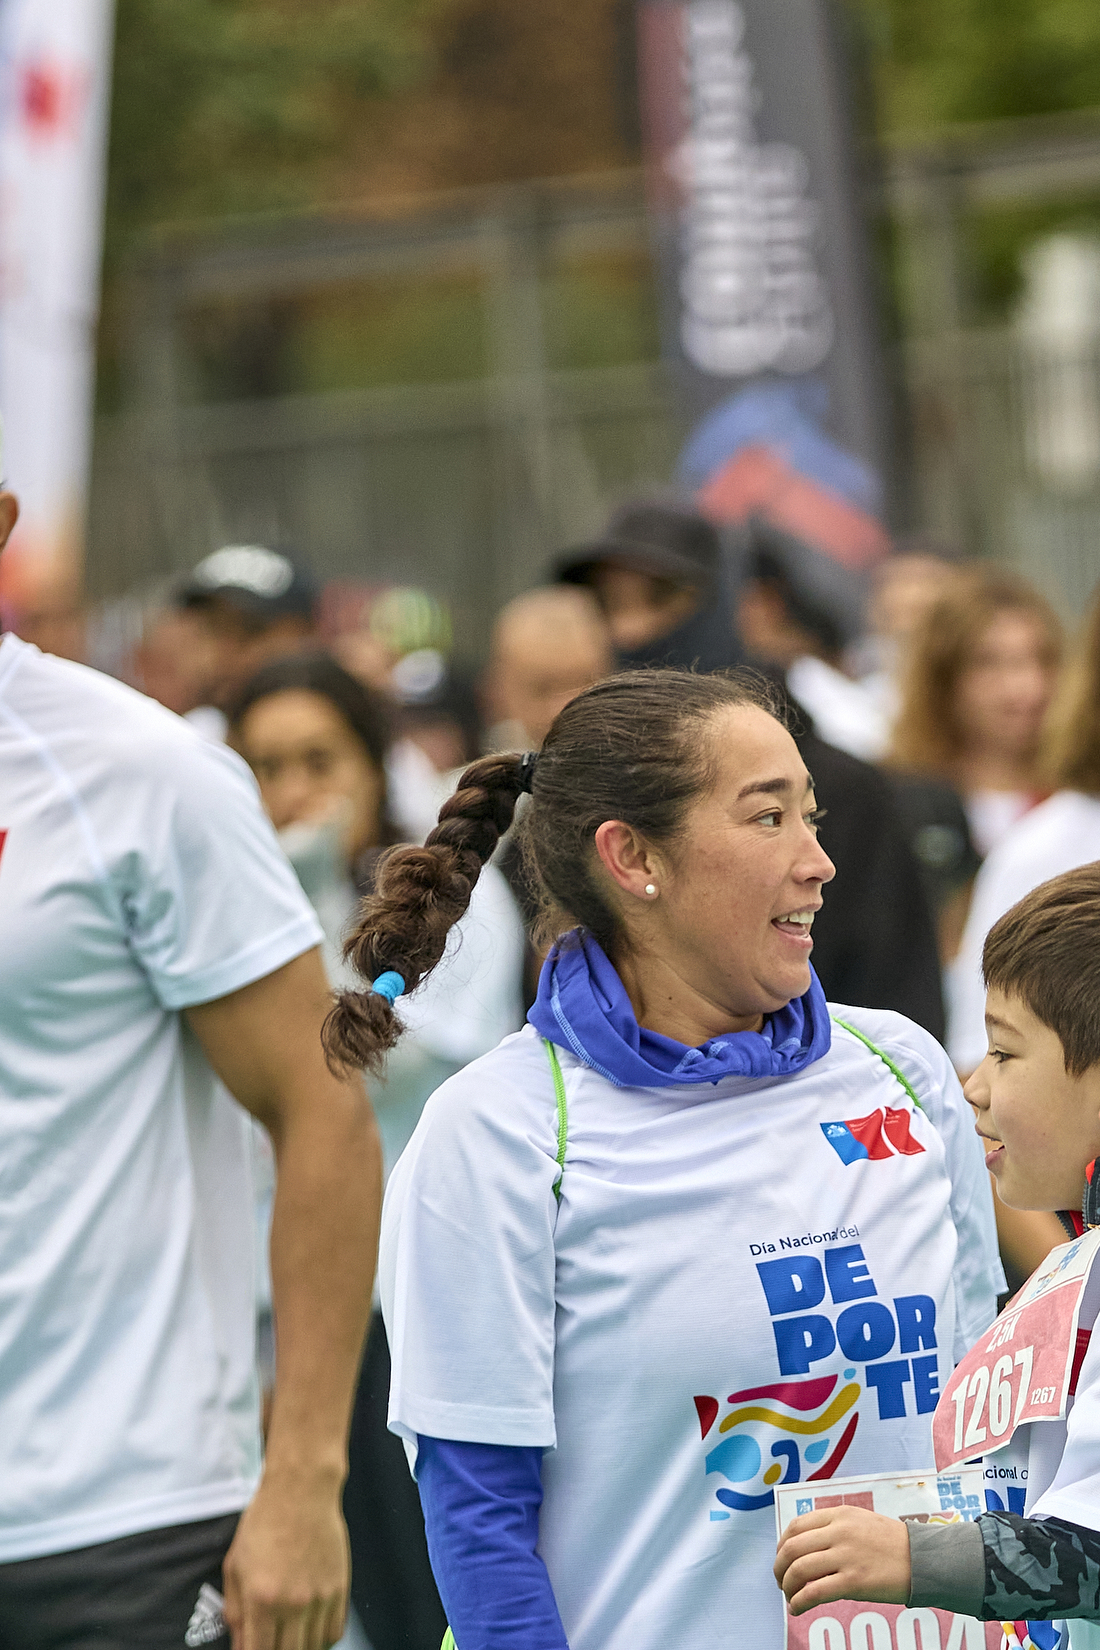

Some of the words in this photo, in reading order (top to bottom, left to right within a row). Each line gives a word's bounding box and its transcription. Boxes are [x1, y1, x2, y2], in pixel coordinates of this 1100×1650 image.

[749, 1242, 777, 1256] Día
[779, 1227, 839, 1250] Nacional
[840, 1224, 860, 1239] del
[756, 1244, 878, 1316] DE
[772, 1295, 938, 1376] POR
[985, 1311, 1023, 1353] 2,5K
[865, 1354, 940, 1420] TE
[951, 1345, 1034, 1453] 1267
[1030, 1386, 1056, 1405] 1267
[937, 1481, 962, 1497] DE
[983, 1465, 1018, 1480] cional
[940, 1494, 981, 1511] POR
